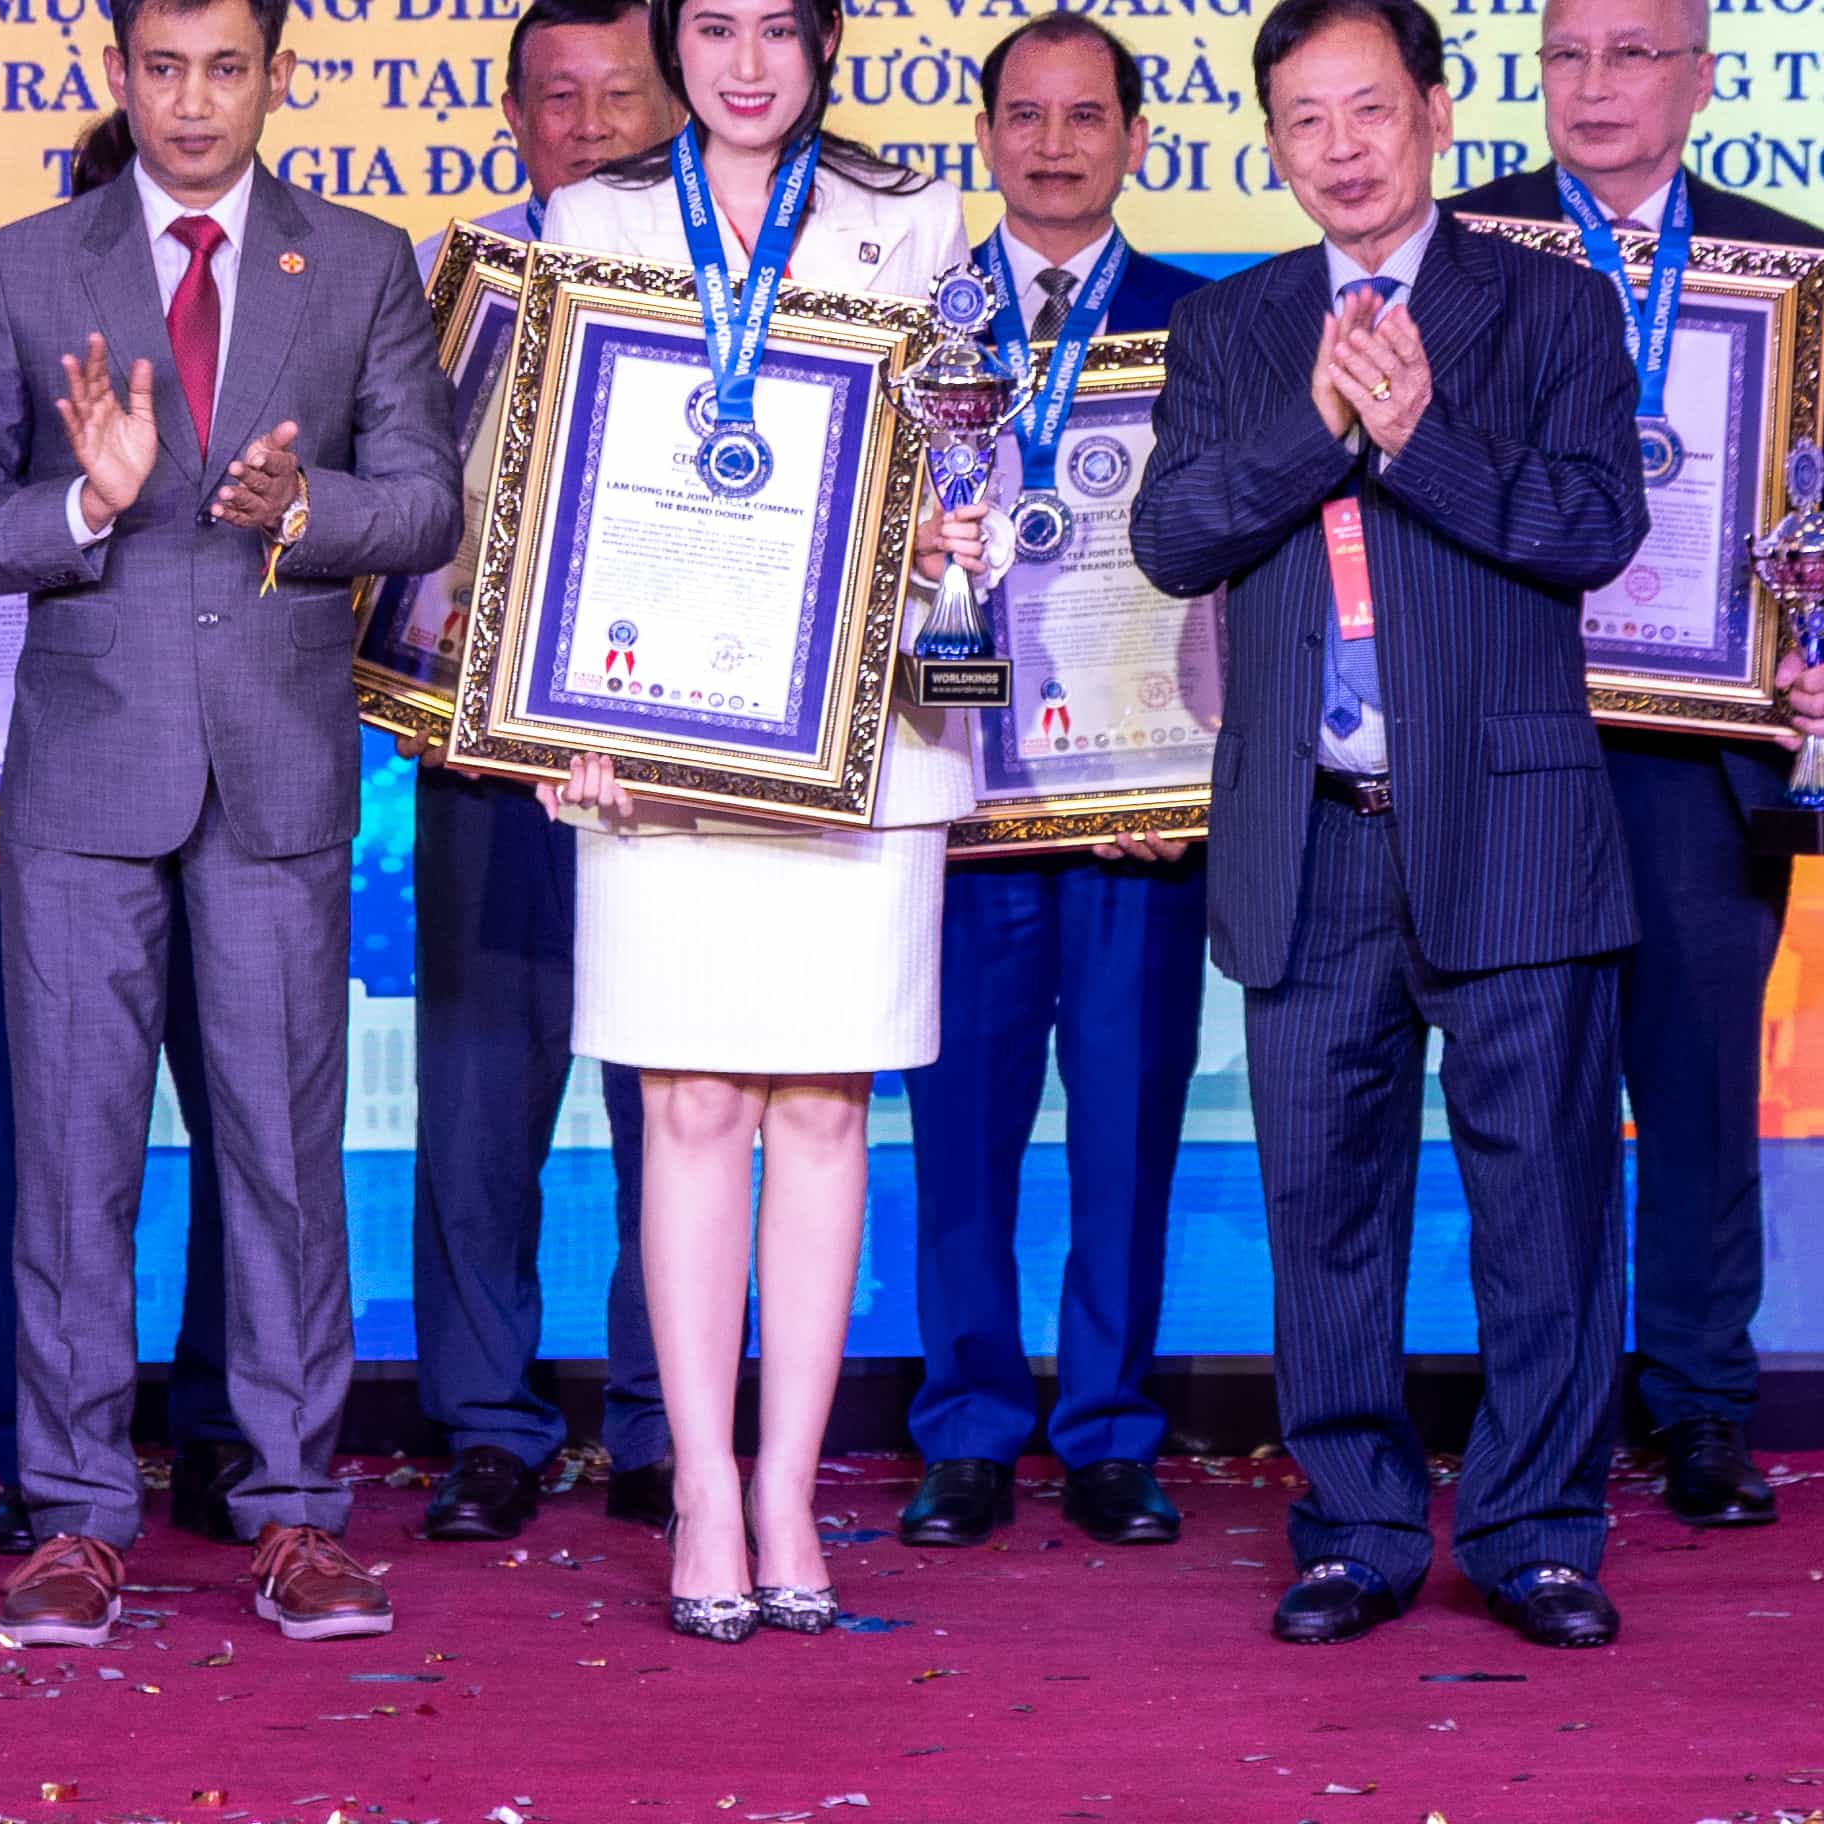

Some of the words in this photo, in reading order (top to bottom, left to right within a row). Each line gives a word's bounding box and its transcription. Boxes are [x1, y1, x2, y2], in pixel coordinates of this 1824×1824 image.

[374, 58, 494, 122] TẠI
[1139, 38, 1241, 112] RÀ,
[277, 145, 406, 196] GIA
[881, 143, 996, 191] TH
[1438, 141, 1544, 189] TR
[676, 131, 707, 228] WORLDKINGS
[734, 266, 776, 376] WORLDKINGS
[1646, 267, 1677, 372] WORLDKINGS
[1038, 340, 1081, 447] WORLDKINGS
[606, 480, 630, 492] LAM
[631, 484, 663, 497] DONG
[665, 489, 684, 500] TEA
[753, 502, 805, 517] COMPANY
[655, 500, 674, 511] THE
[676, 504, 713, 517] BRAND
